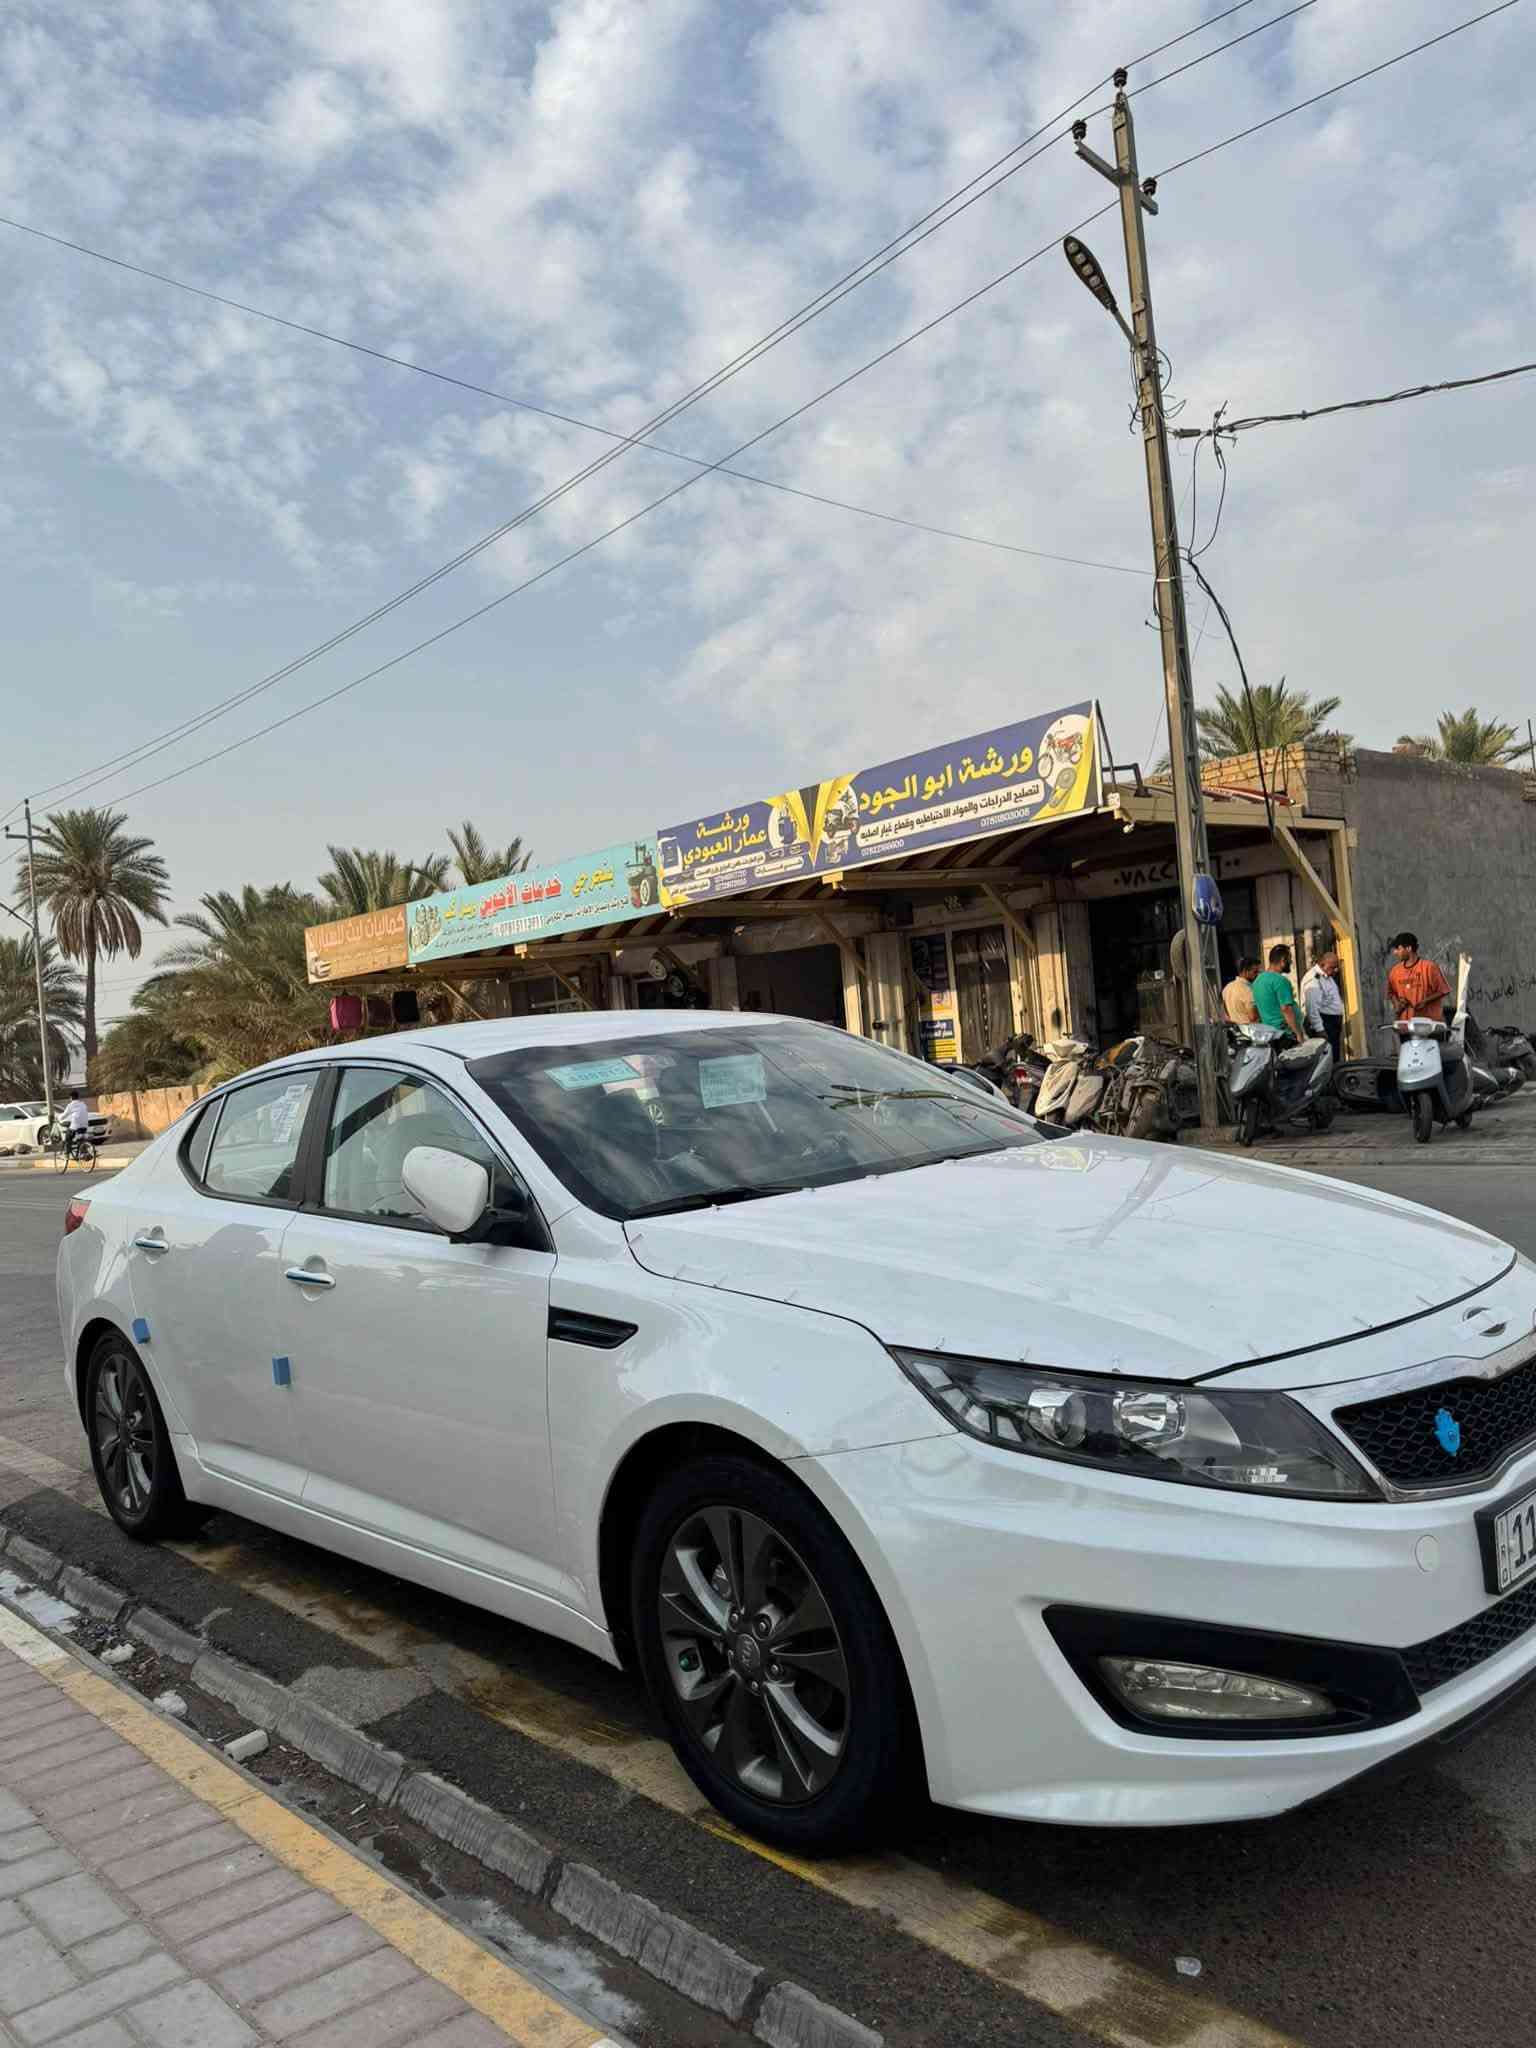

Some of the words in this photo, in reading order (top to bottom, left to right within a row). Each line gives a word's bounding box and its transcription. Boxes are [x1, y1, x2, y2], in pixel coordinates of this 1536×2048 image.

[922, 763, 953, 801] ابو
[958, 745, 1034, 785] ورشة
[858, 773, 918, 816] الجود
[696, 811, 750, 839] ورشة
[733, 829, 767, 854] عمار
[683, 836, 733, 870] العبودي
